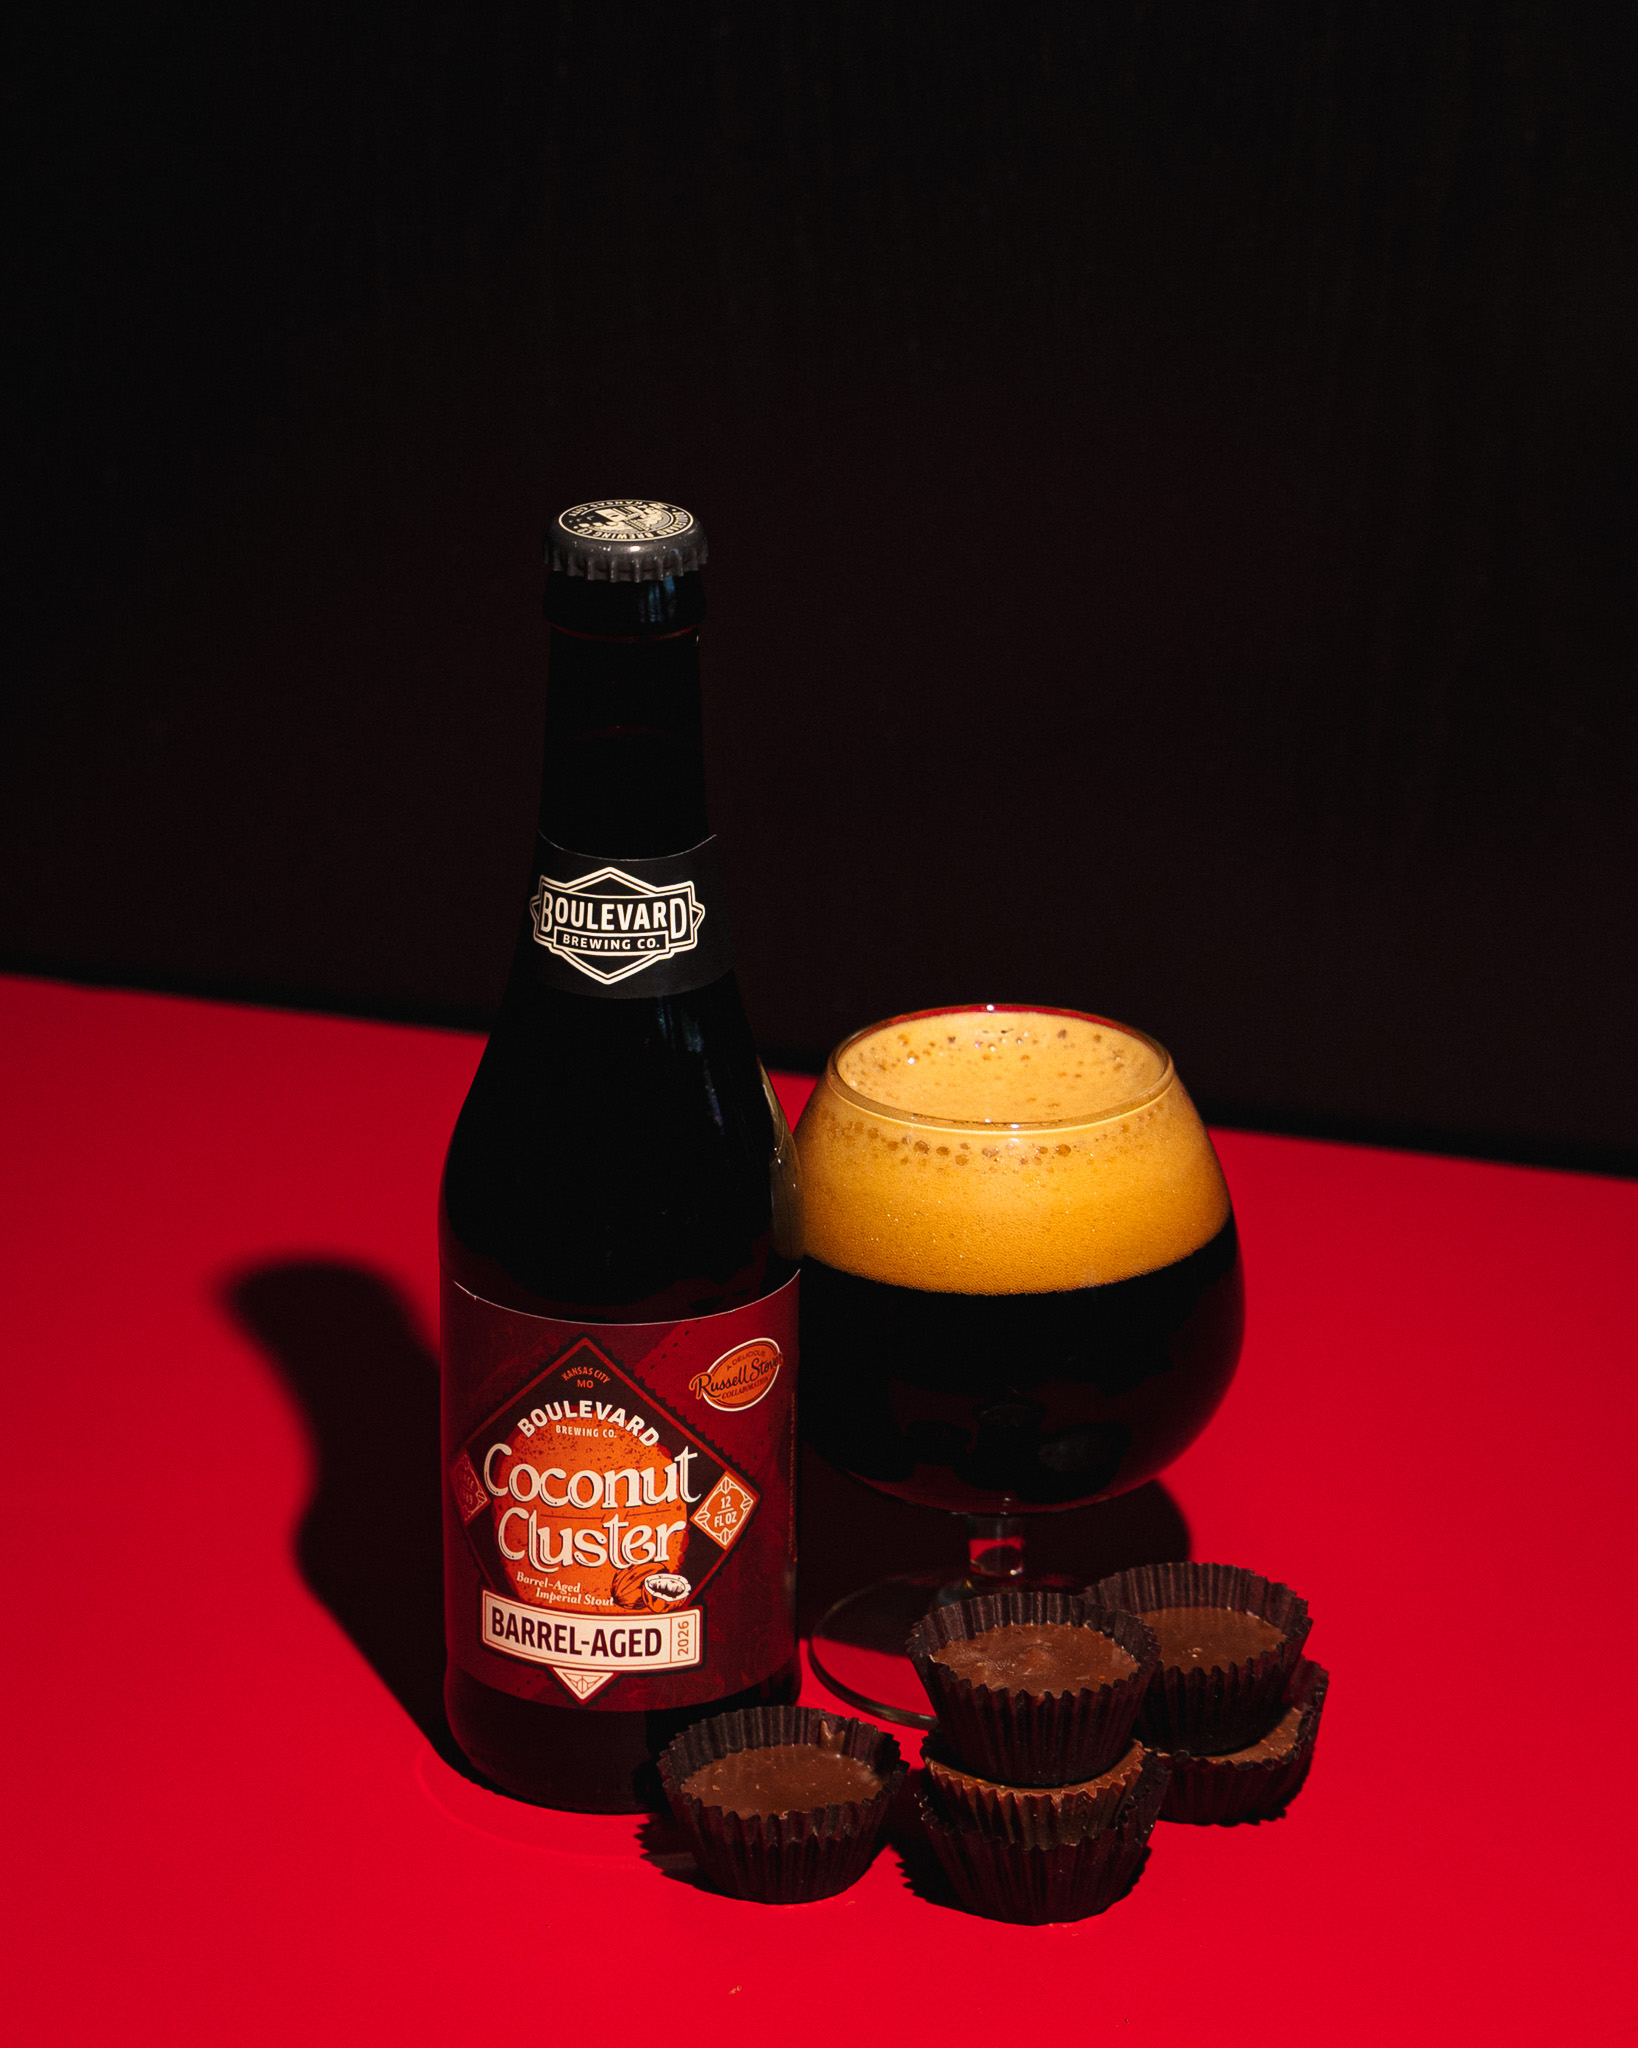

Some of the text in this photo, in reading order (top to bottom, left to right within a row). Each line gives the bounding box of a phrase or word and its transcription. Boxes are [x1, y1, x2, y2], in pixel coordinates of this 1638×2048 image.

[540, 891, 688, 940] BOULEVARD
[562, 934, 661, 950] BREWING CO.
[561, 1366, 612, 1384] KANSAS CITY
[576, 1379, 594, 1389] MO
[690, 1365, 749, 1398] Russell
[516, 1400, 660, 1447] BOULEVARD
[555, 1424, 618, 1439] BREWING CO.
[483, 1443, 702, 1510] Coconut
[720, 1495, 732, 1509] 12
[714, 1510, 737, 1528] FL OZ
[498, 1507, 687, 1573] Cluster
[516, 1571, 581, 1594] Barrel-Aged
[535, 1588, 615, 1607] Imperial Stout
[491, 1605, 663, 1658] BARREL-AGED
[677, 1620, 690, 1656] 2026
